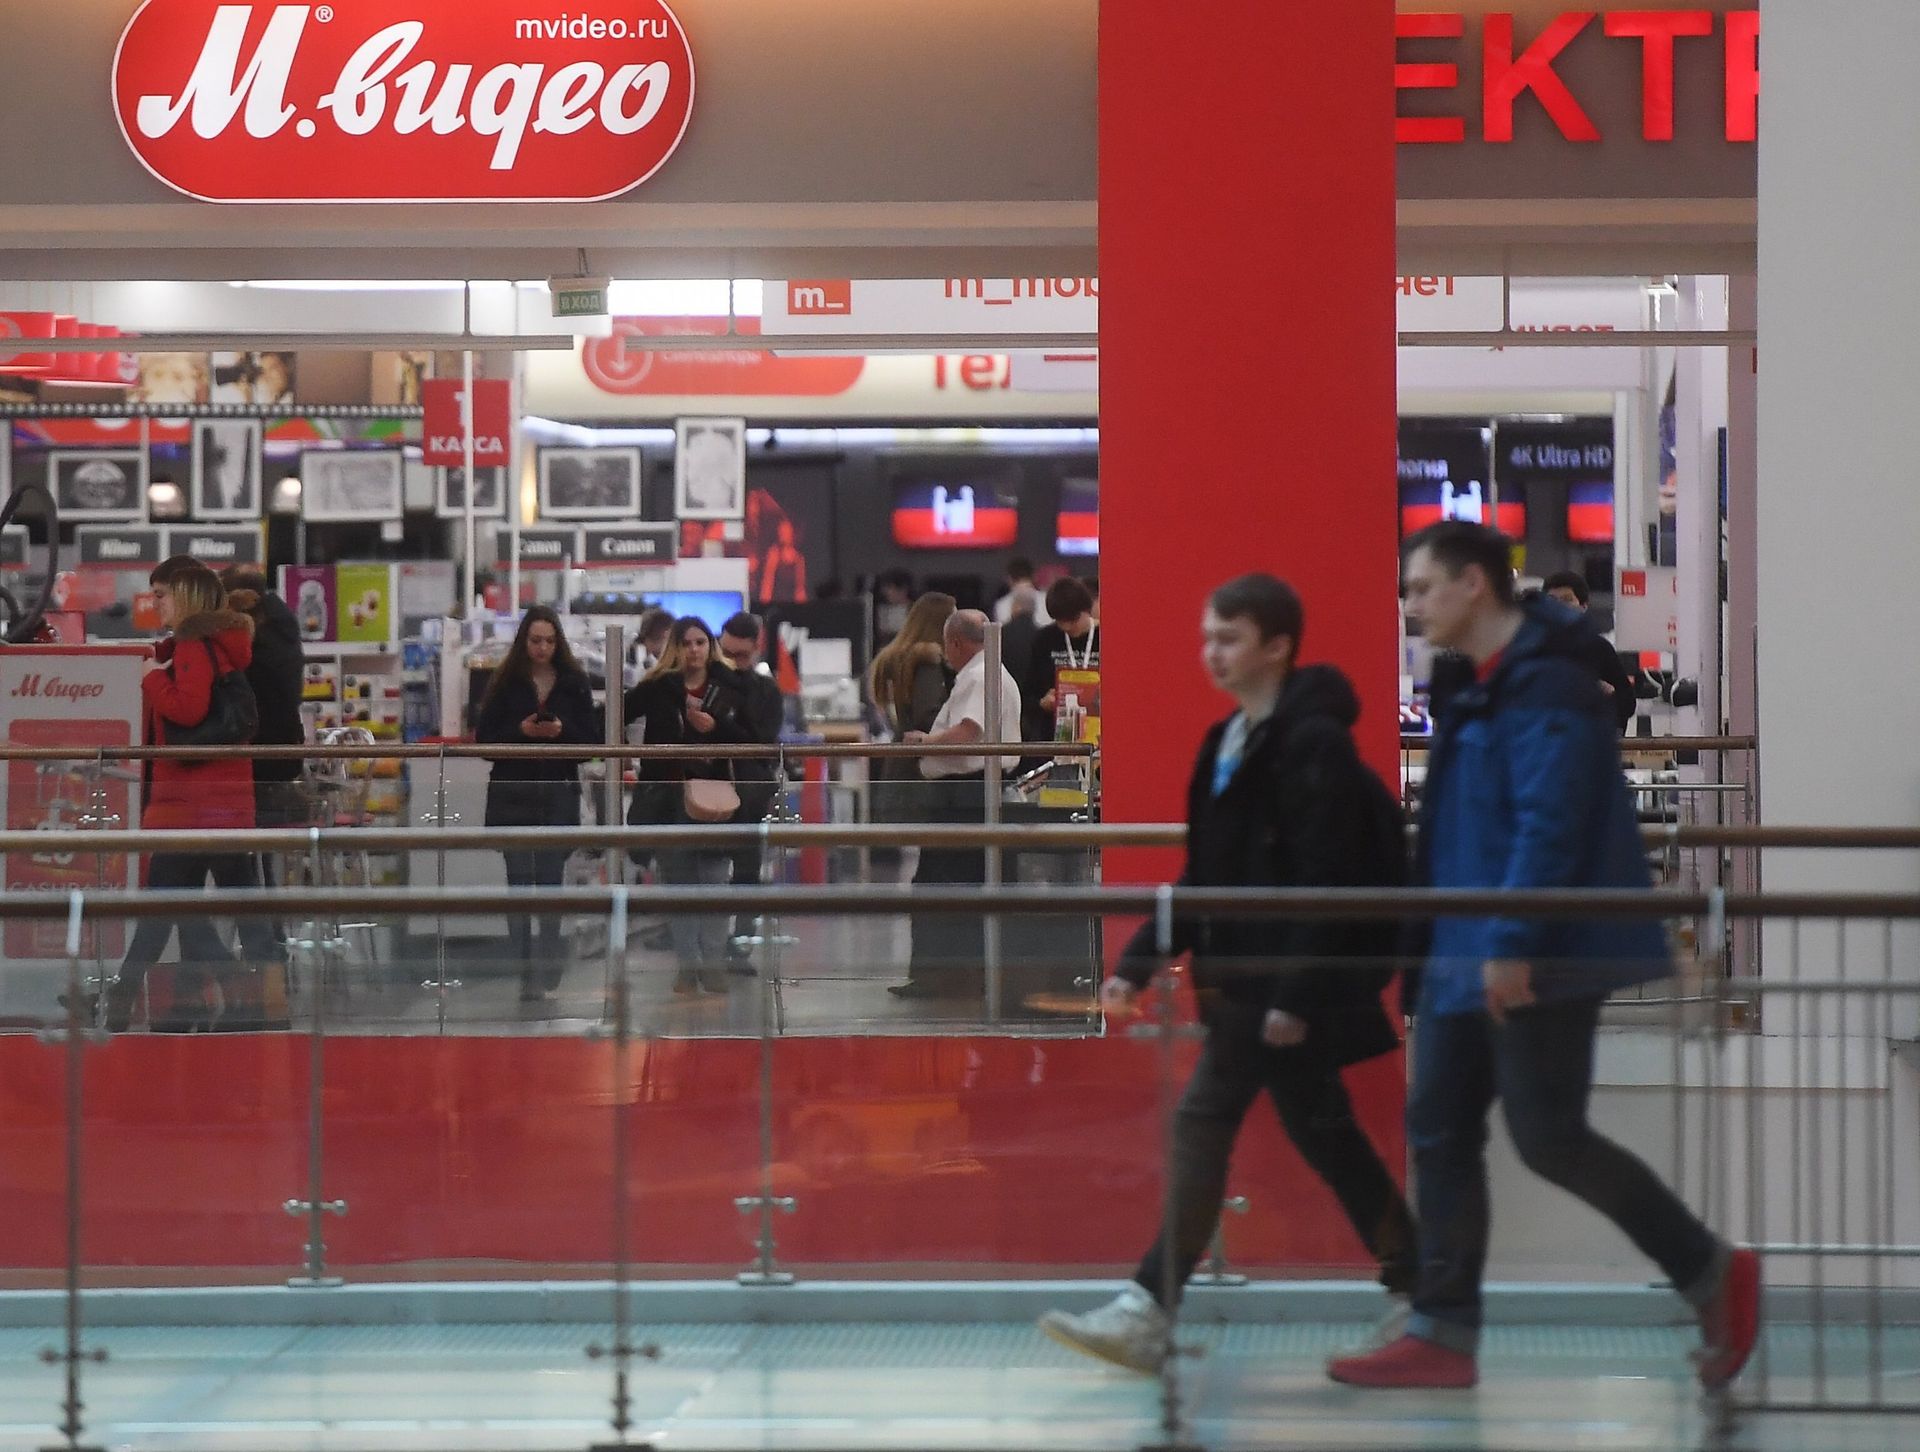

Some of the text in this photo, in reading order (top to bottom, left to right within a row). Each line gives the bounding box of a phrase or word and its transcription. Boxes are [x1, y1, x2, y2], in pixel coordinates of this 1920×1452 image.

[514, 14, 669, 40] mvideo.ru
[794, 285, 844, 309] m_
[429, 435, 504, 454] КАСА
